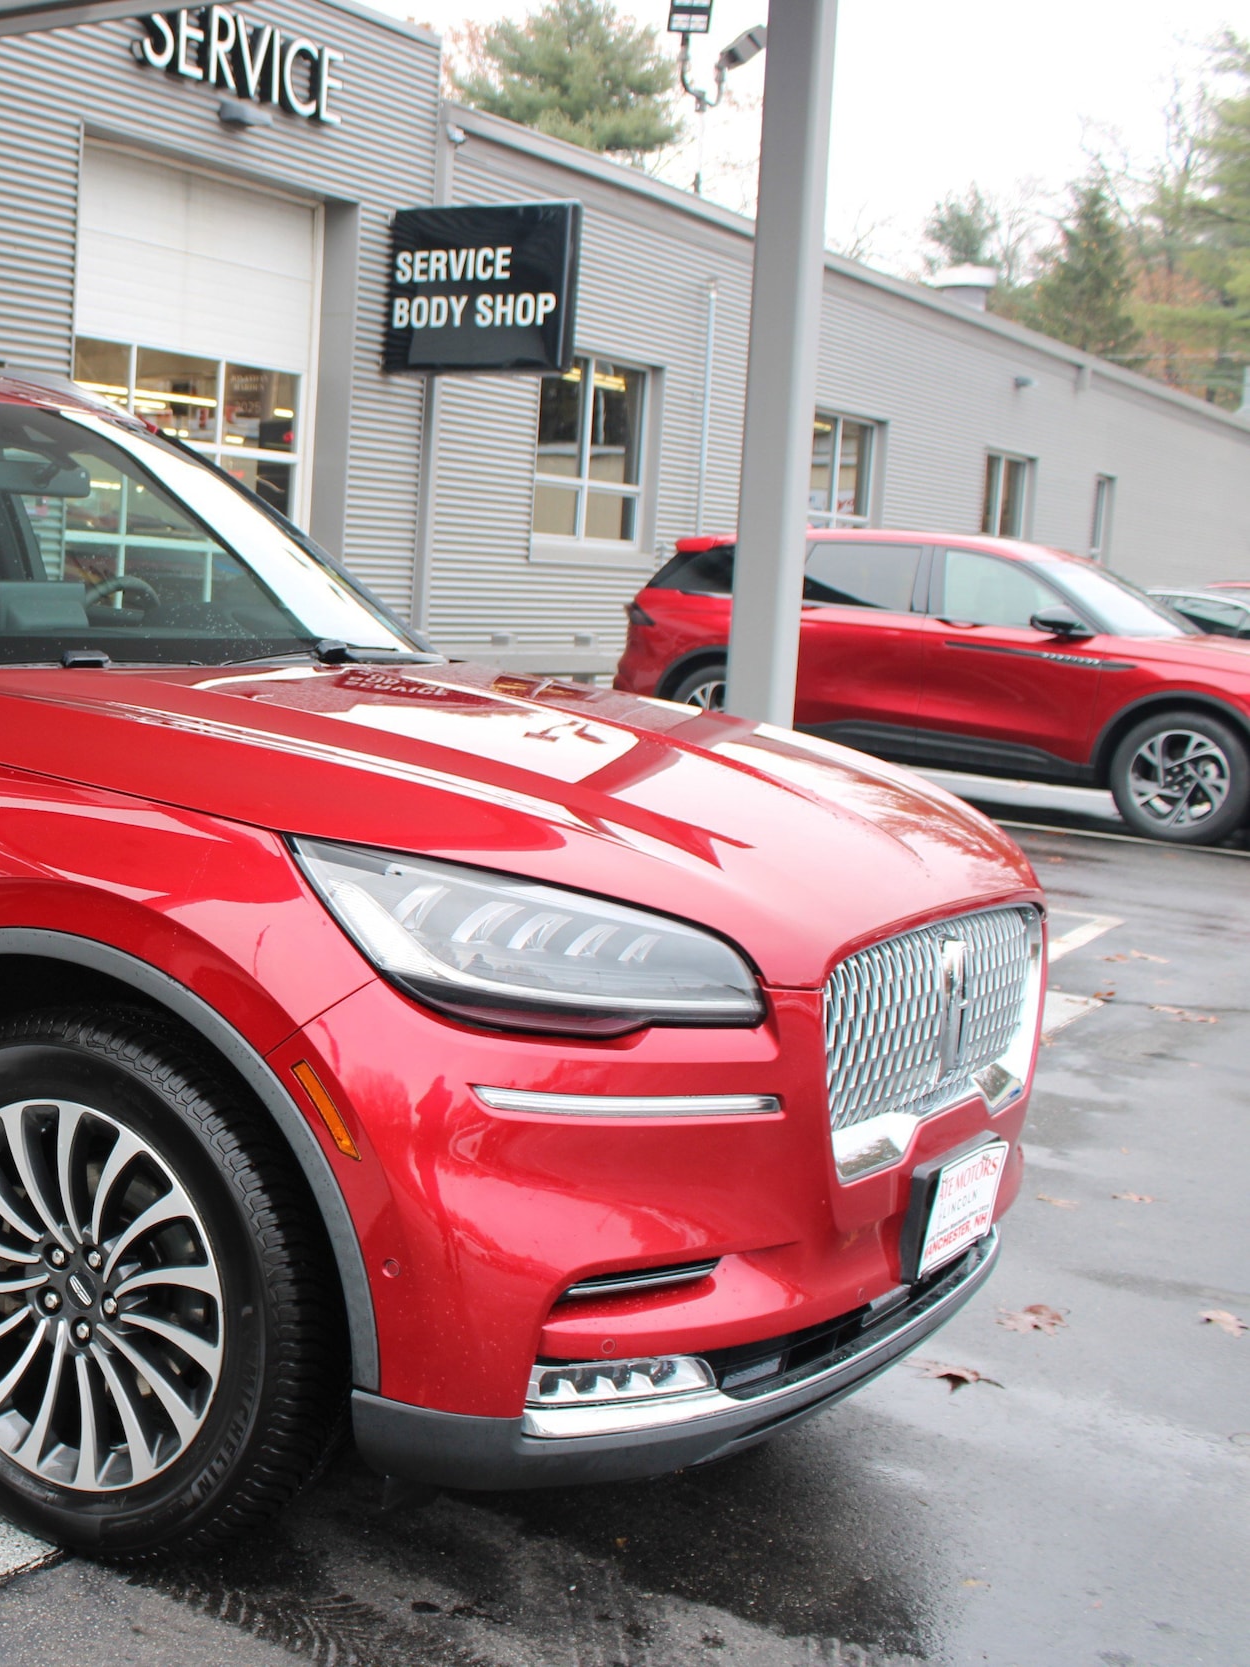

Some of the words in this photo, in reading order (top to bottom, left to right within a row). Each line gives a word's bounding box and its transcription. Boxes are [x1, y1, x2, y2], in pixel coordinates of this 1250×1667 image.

[143, 5, 344, 124] SERVICE
[395, 247, 512, 284] SERVICE
[392, 295, 468, 329] BODY
[474, 292, 556, 327] SHOP
[956, 1157, 998, 1190] MOTORS
[942, 1190, 978, 1218] LINCOLN
[974, 1211, 989, 1228] NH
